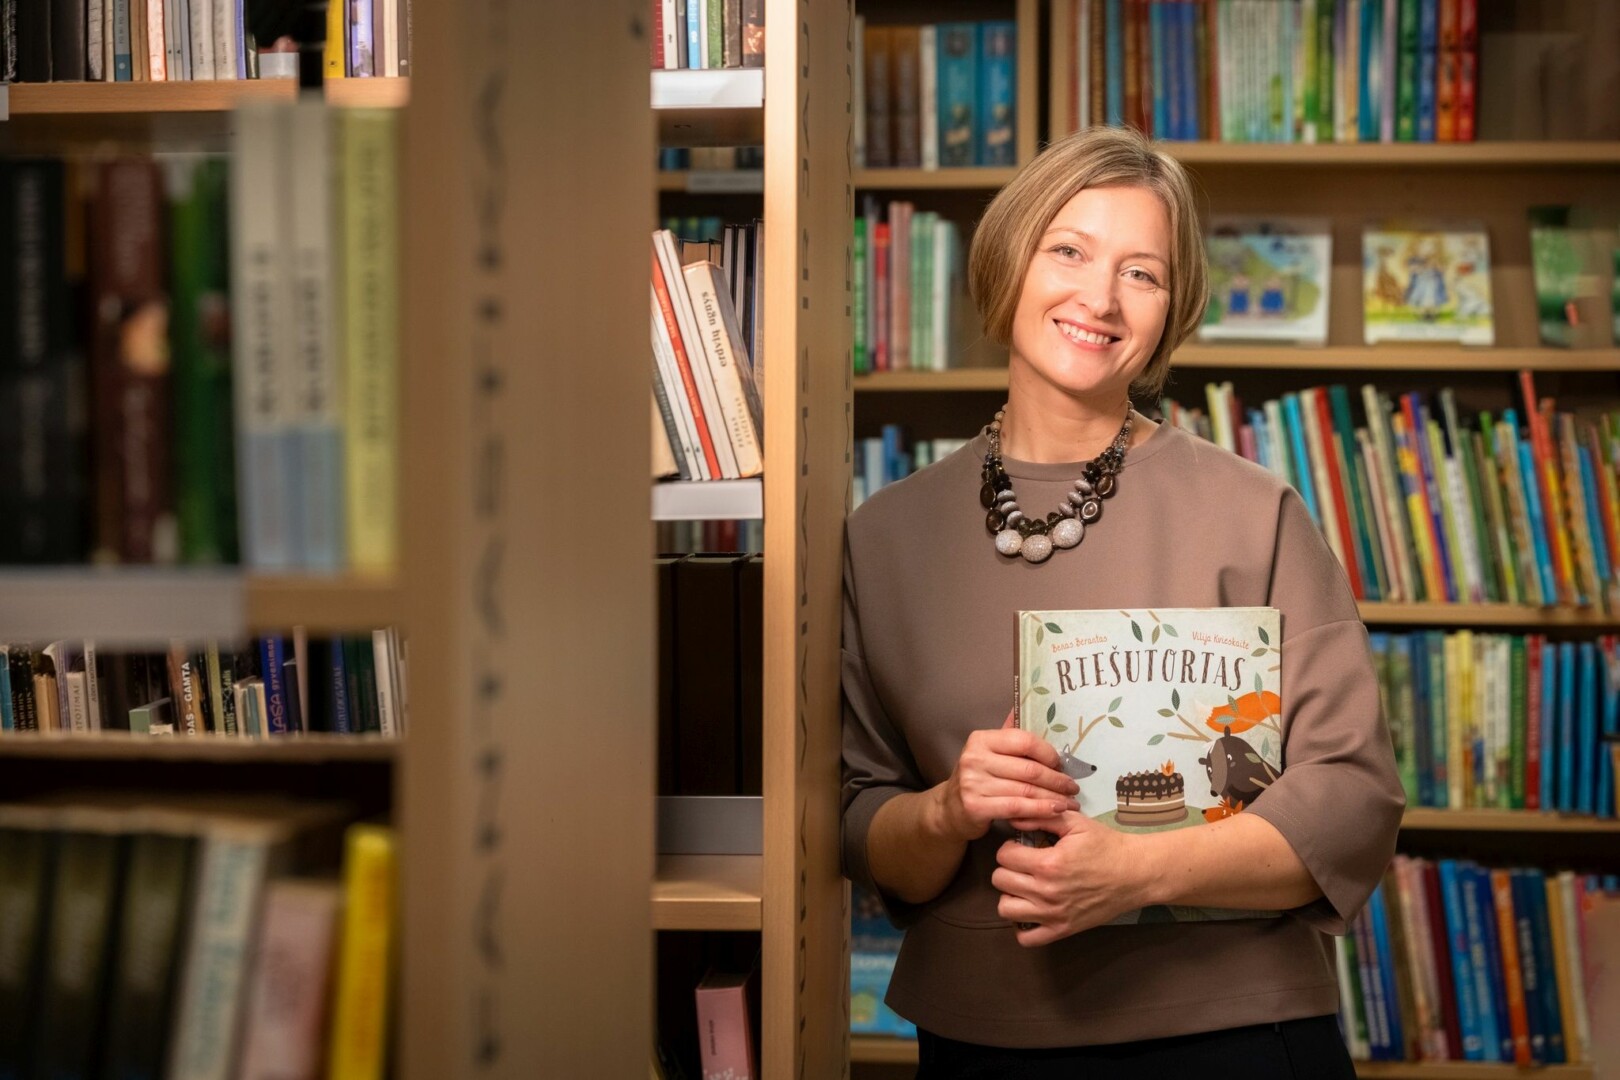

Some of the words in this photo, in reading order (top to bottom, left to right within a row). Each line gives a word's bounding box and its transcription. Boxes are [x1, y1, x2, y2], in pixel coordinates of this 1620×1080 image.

[702, 291, 716, 326] ugnys
[712, 329, 727, 368] erdvių
[1051, 643, 1074, 653] Benas
[1075, 634, 1108, 647] Berantas
[1192, 631, 1212, 646] Vilija
[181, 661, 193, 702] GAMTA
[267, 638, 280, 691] gyvenimas
[1055, 645, 1246, 696] RIEŠUTORTAS
